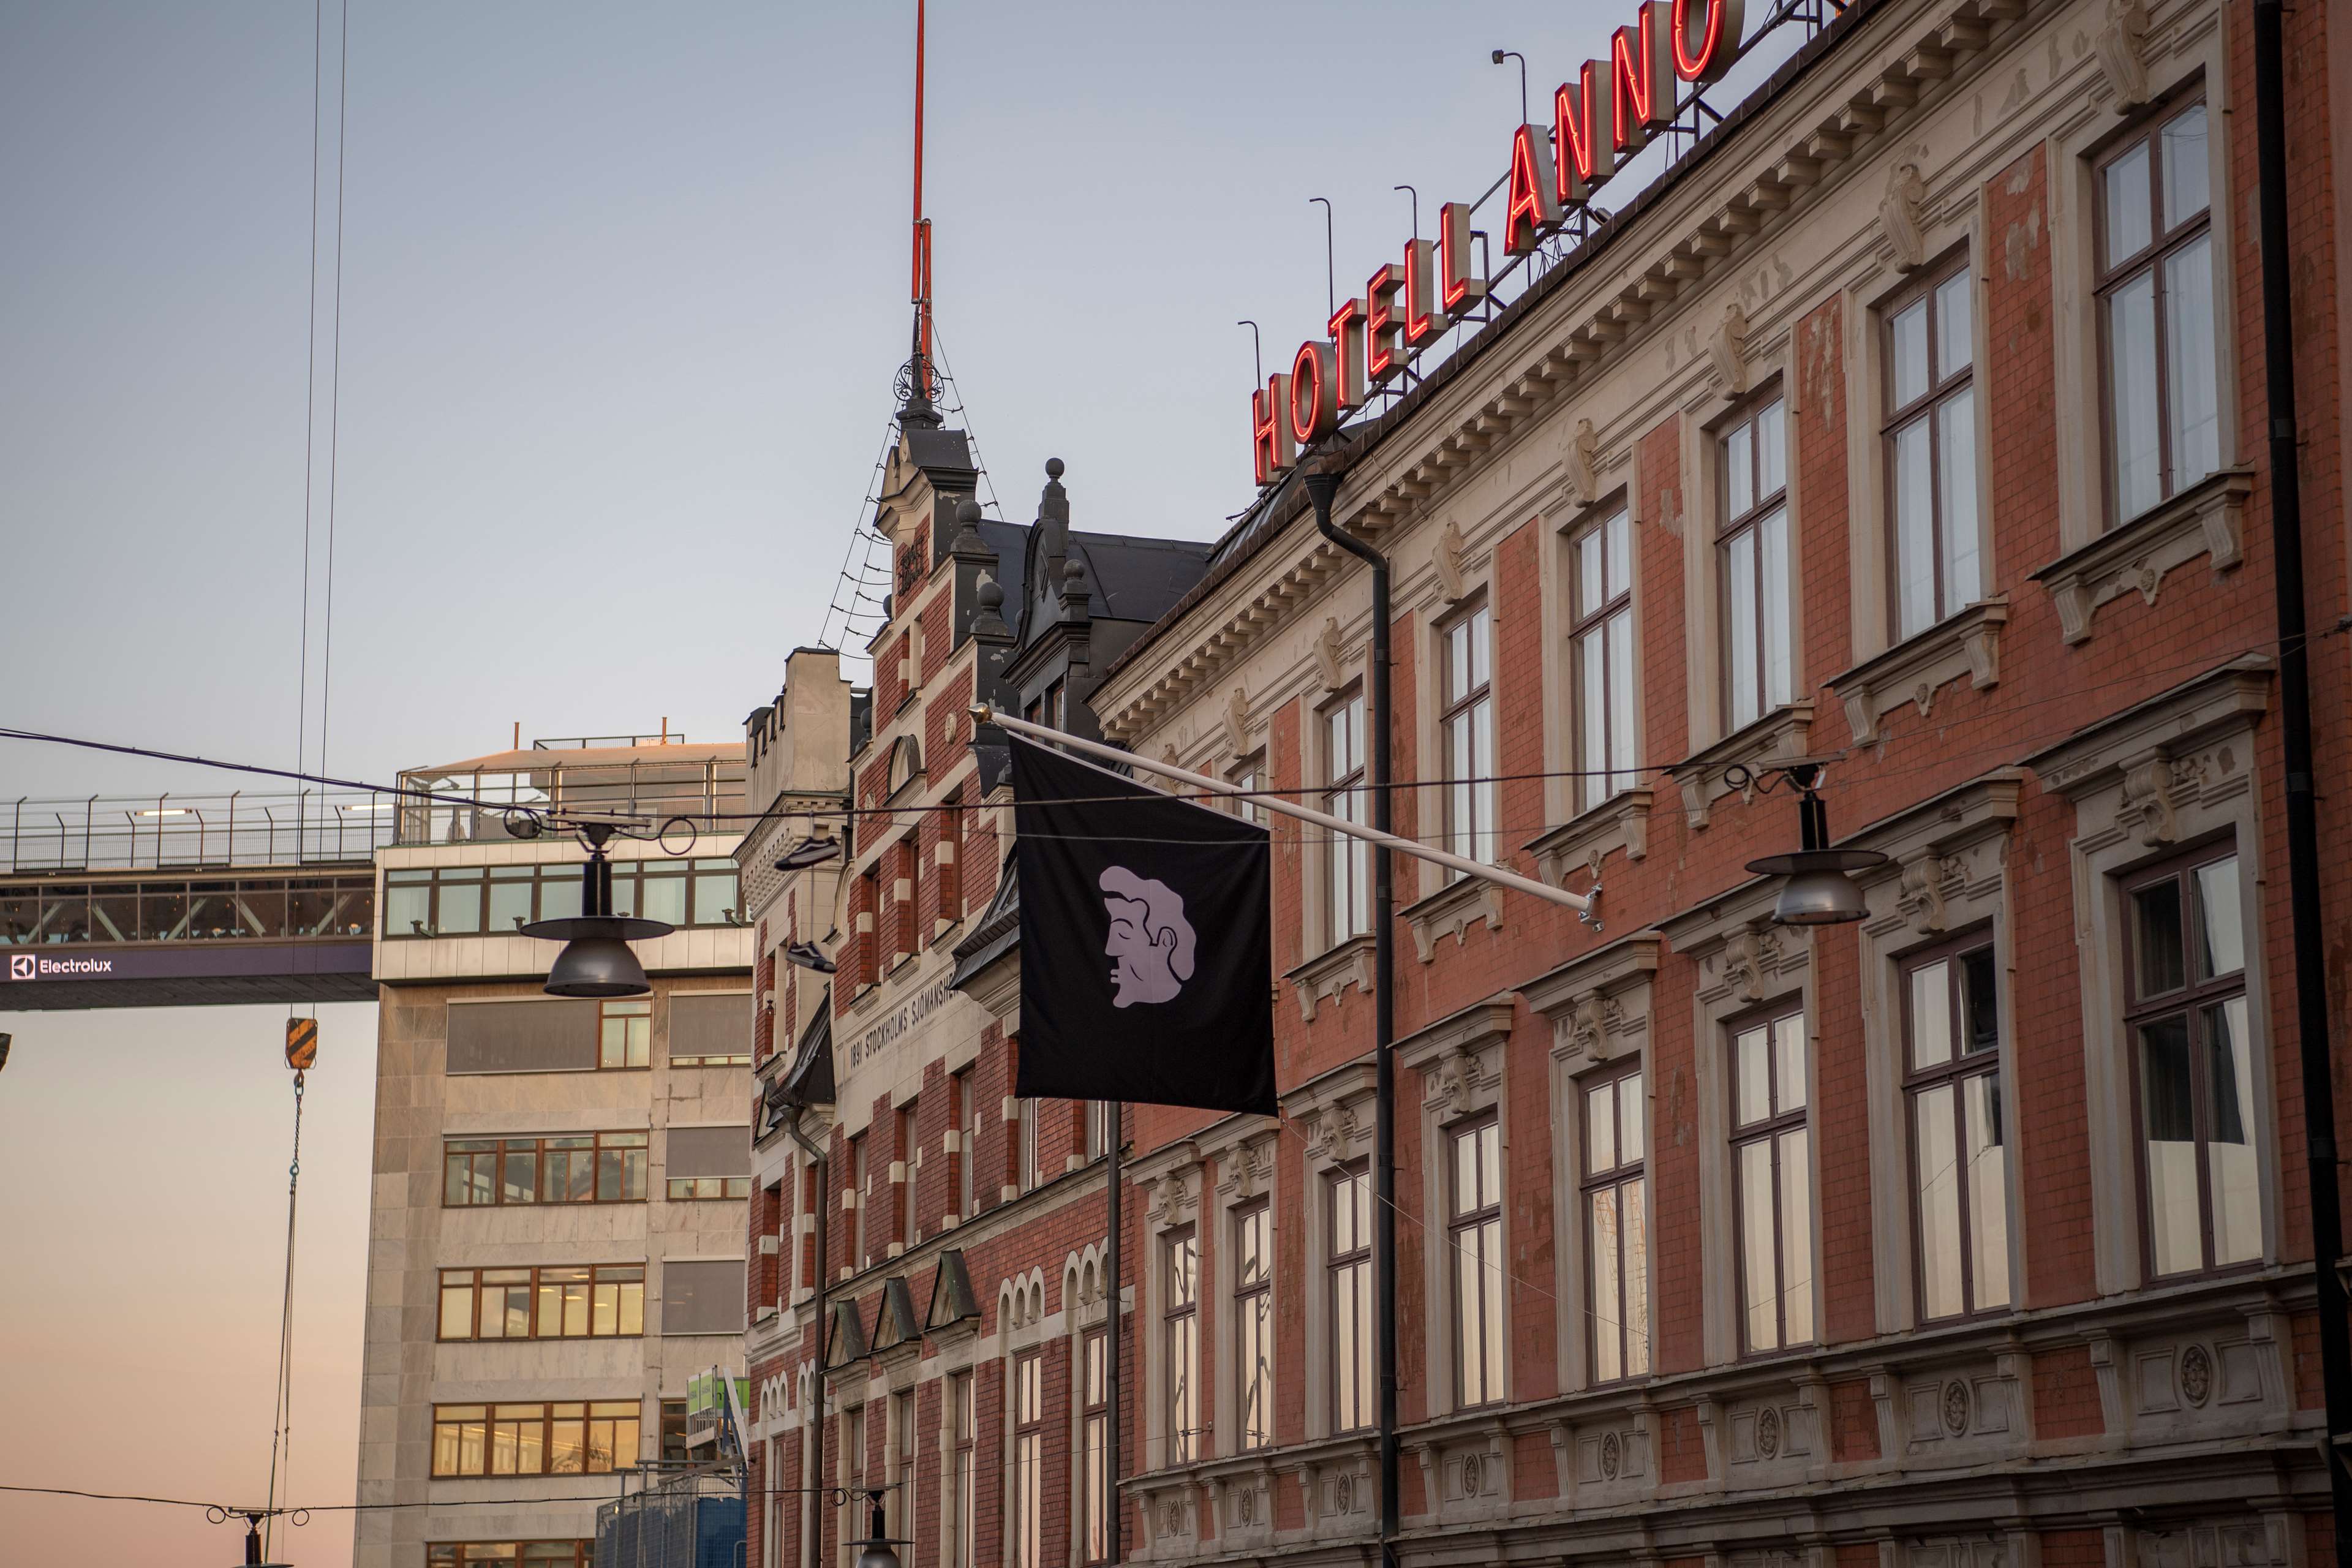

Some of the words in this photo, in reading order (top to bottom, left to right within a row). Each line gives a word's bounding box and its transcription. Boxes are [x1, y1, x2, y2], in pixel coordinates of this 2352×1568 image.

[1252, 203, 1485, 486] HOTELL
[1504, 0, 1744, 256] ANNO
[39, 959, 112, 973] Electrolux
[851, 1039, 862, 1069] 1891
[865, 1007, 908, 1058] STOCKHOLMS
[911, 971, 959, 1026] SJÖMANSHE
